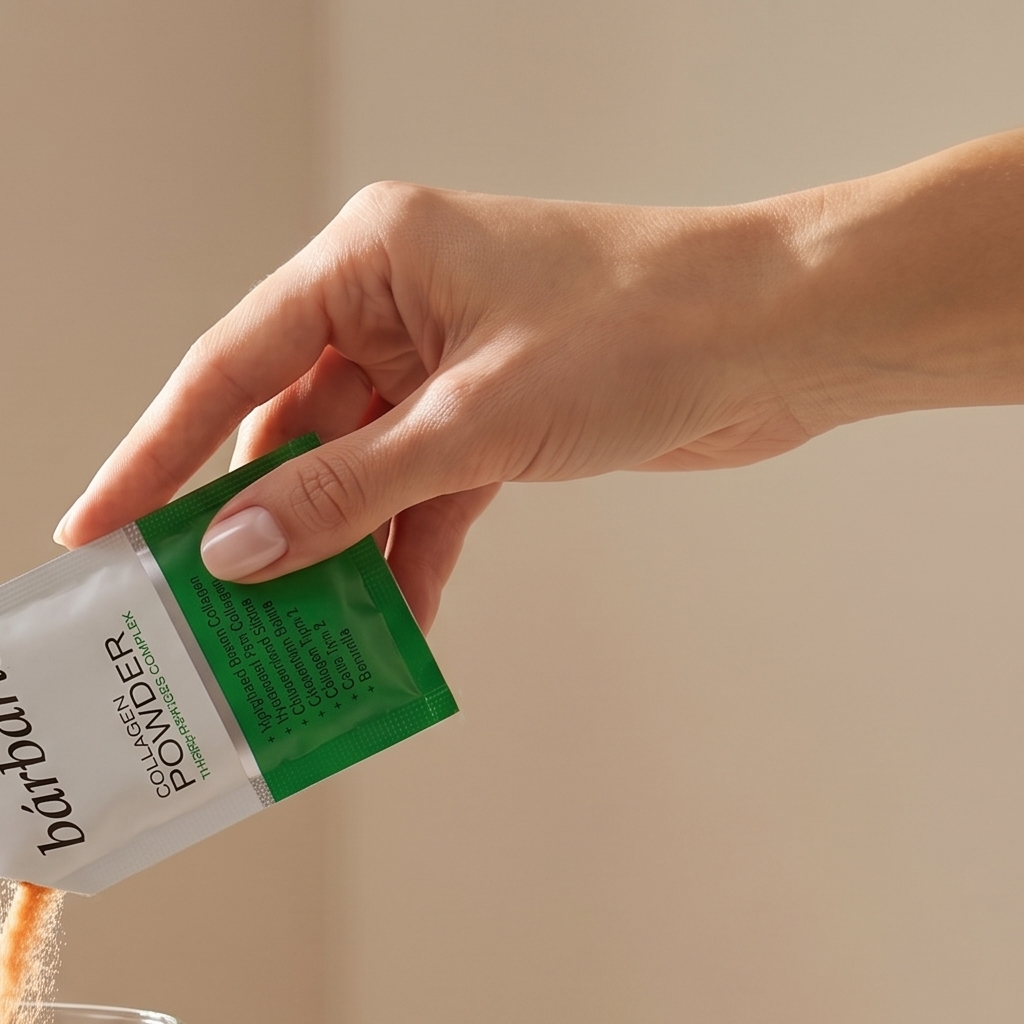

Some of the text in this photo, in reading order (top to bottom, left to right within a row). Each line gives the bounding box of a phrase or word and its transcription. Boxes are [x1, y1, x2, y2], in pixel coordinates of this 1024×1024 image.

[122, 610, 160, 675] COMPLEX
[105, 631, 196, 791] POWDER
[112, 695, 171, 798] COLLAGEN
